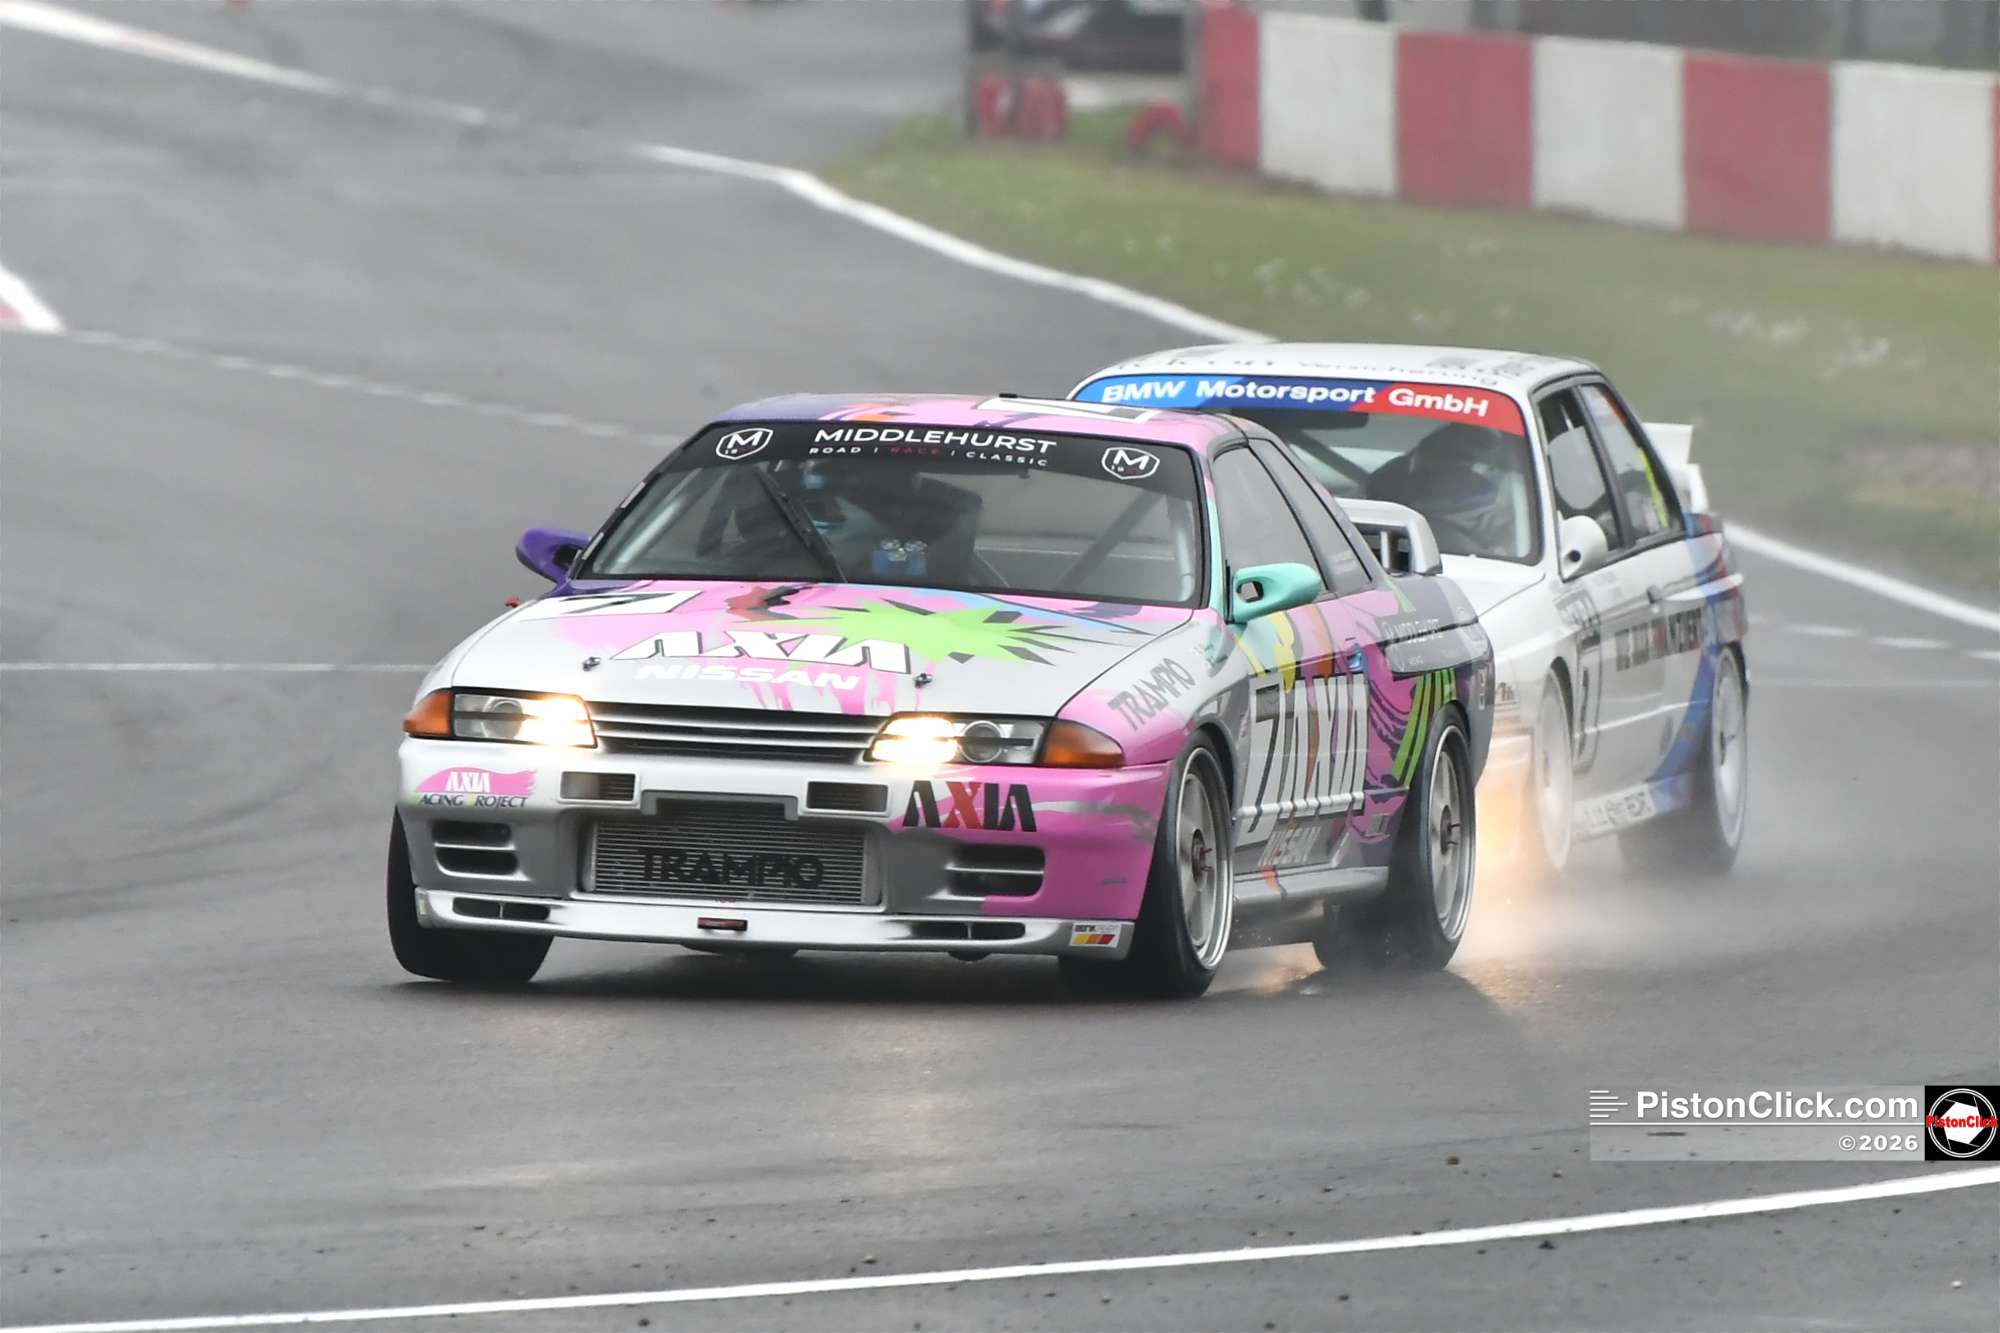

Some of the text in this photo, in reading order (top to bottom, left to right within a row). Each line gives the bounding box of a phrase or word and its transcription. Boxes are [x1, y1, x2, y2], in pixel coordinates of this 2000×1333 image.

[1101, 381, 1489, 417] BMW Motorsport GmbH
[814, 428, 1057, 453] MIDDLEHURST
[808, 446, 862, 455] ROAD
[966, 451, 1048, 466] CLASSIC
[610, 631, 911, 674] AXIA
[635, 665, 860, 690] NISSAN
[1278, 674, 1368, 820] AXIA
[445, 771, 491, 792] AXIA
[902, 780, 1037, 832] AXIA
